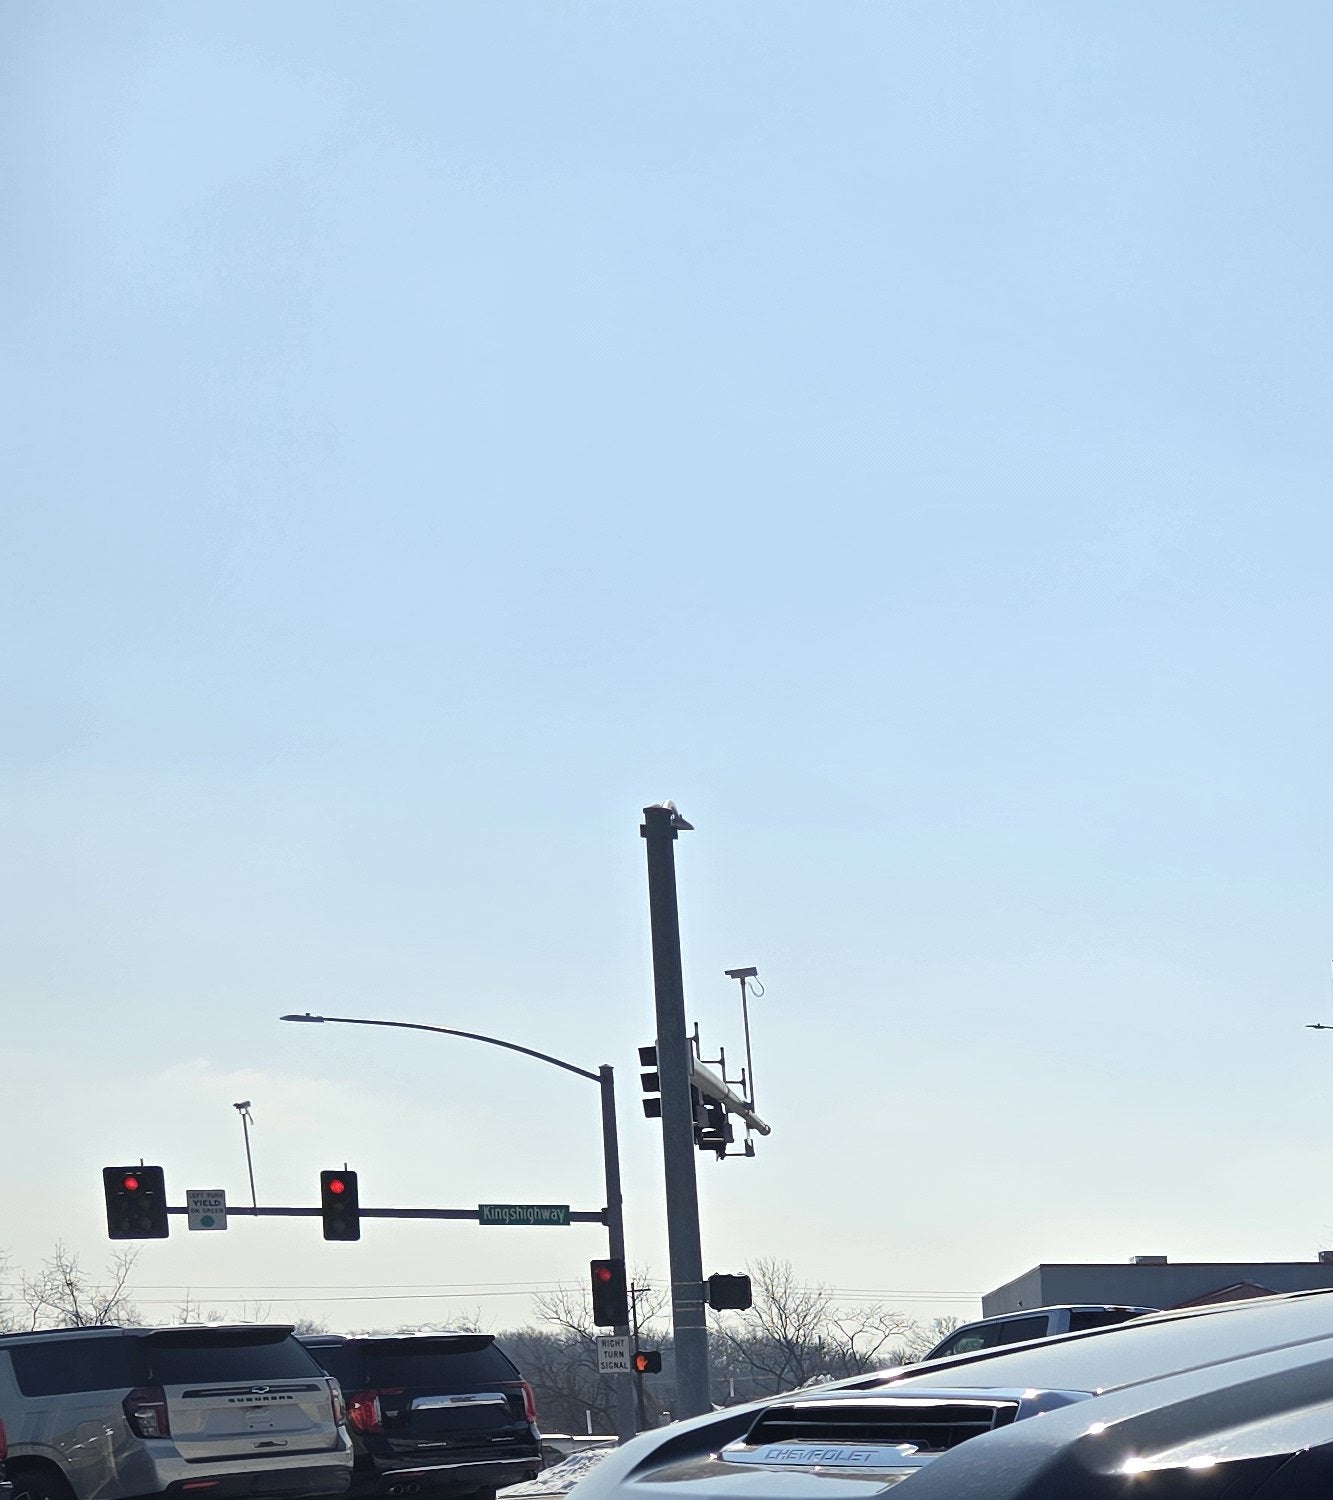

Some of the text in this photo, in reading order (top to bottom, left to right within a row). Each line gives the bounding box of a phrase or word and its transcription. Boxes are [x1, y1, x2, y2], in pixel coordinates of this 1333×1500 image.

[192, 1199, 221, 1207] YIELD
[483, 1205, 566, 1224] Kingshighway
[602, 1339, 624, 1347] RIGHT
[601, 1361, 628, 1369] SIGNAL
[764, 1449, 880, 1462] CHEVROLET
